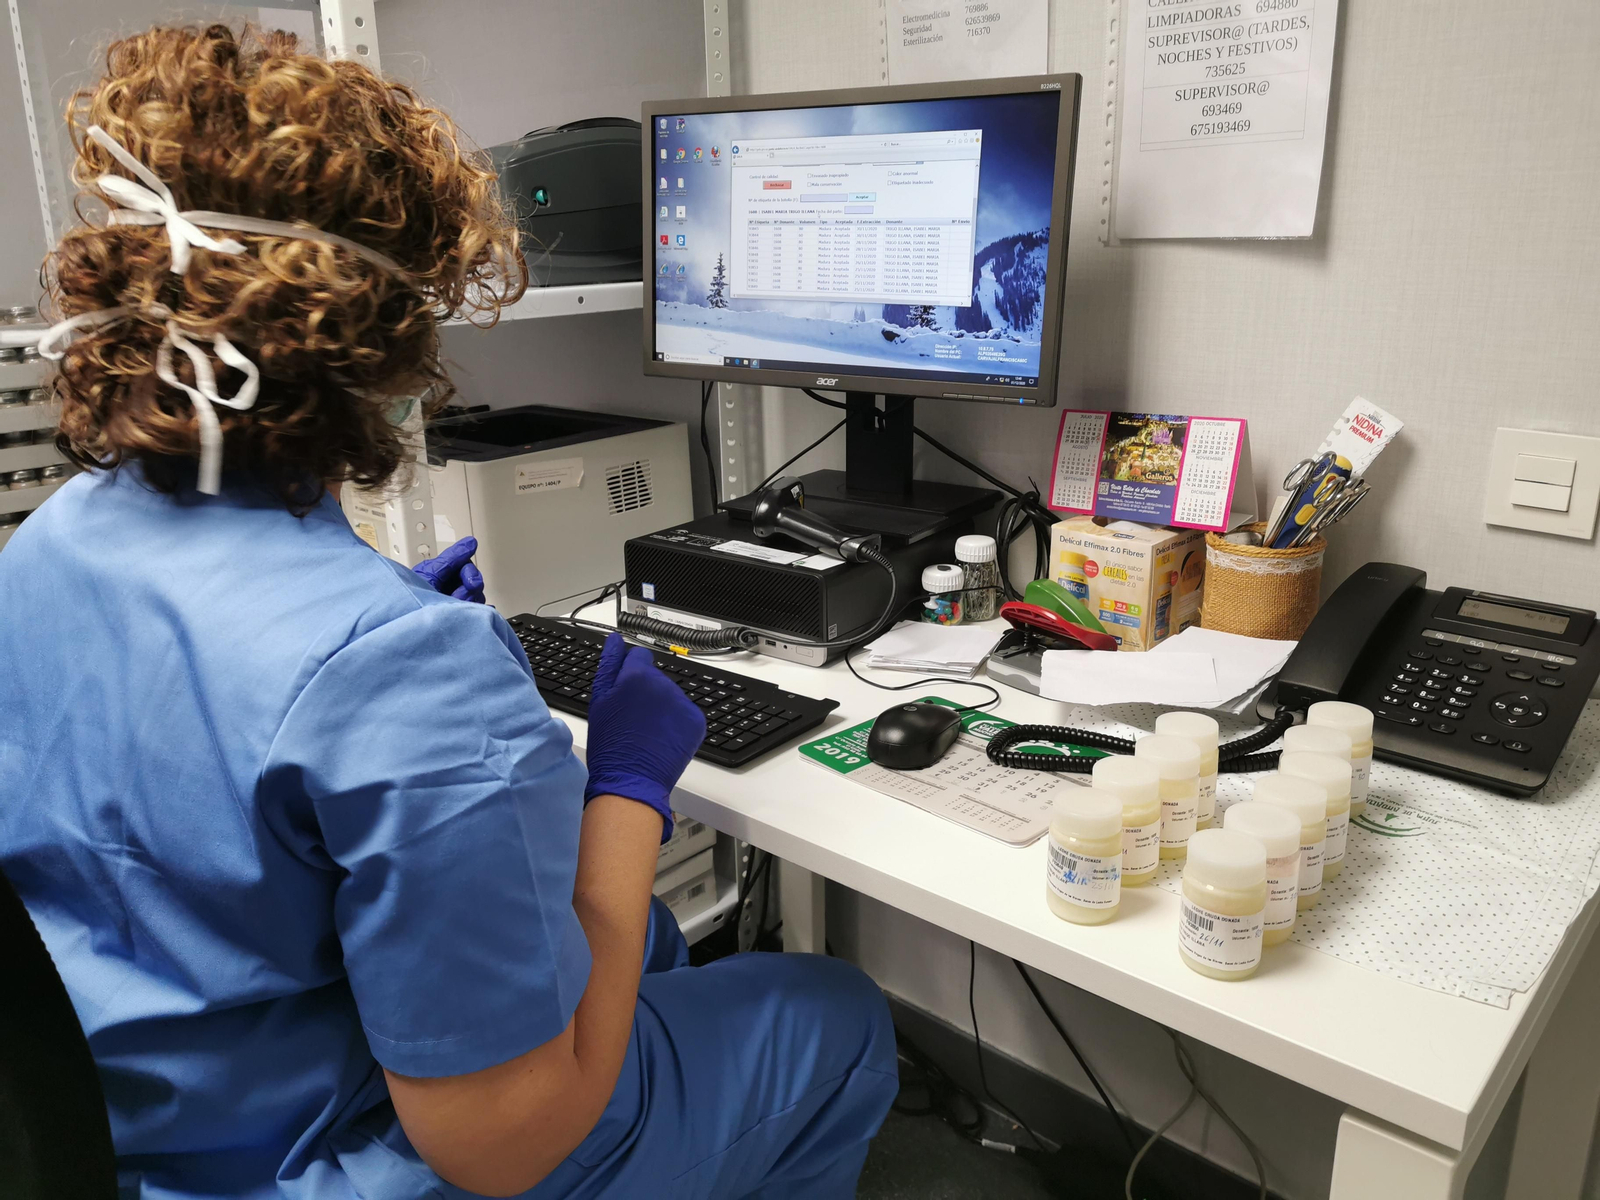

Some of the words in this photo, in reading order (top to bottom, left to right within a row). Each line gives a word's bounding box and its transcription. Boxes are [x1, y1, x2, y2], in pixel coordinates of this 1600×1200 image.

[965, 2, 988, 14] 769886
[1148, 4, 1242, 28] LIMPIADORAS
[902, 10, 950, 24] Electromedicina
[965, 12, 1001, 26] 626539869
[902, 24, 932, 36] Seguridad
[966, 26, 991, 37] 716370
[1148, 25, 1244, 48] SUPREVISOR@
[1248, 16, 1310, 39] (TARDES,
[903, 34, 943, 46] Esterilización
[1157, 48, 1212, 66] NOCHES
[1216, 46, 1226, 58] Y
[1228, 36, 1298, 58] FESTIVOS)
[1205, 62, 1246, 78] 735625
[1174, 80, 1270, 102] SUPERVISOR@
[1202, 102, 1242, 117] 693469
[1190, 119, 1250, 136] 675193469
[816, 377, 838, 386] acer
[1352, 414, 1383, 438] NIDINA
[1348, 425, 1374, 444] PREMIUM
[1146, 472, 1174, 482] Galleros
[1059, 535, 1082, 546] Delical
[1084, 540, 1109, 552] Effimax
[1110, 545, 1121, 554] 2.0
[1103, 566, 1128, 581] CEREALES
[1112, 561, 1126, 570] único
[1127, 564, 1144, 572] sabor
[1062, 580, 1086, 594] Delical
[1110, 578, 1126, 587] dietas
[813, 743, 861, 764] 2019
[1192, 905, 1203, 915] LECHE
[1204, 912, 1220, 921] CRUDA
[1199, 932, 1225, 948] 26/11
